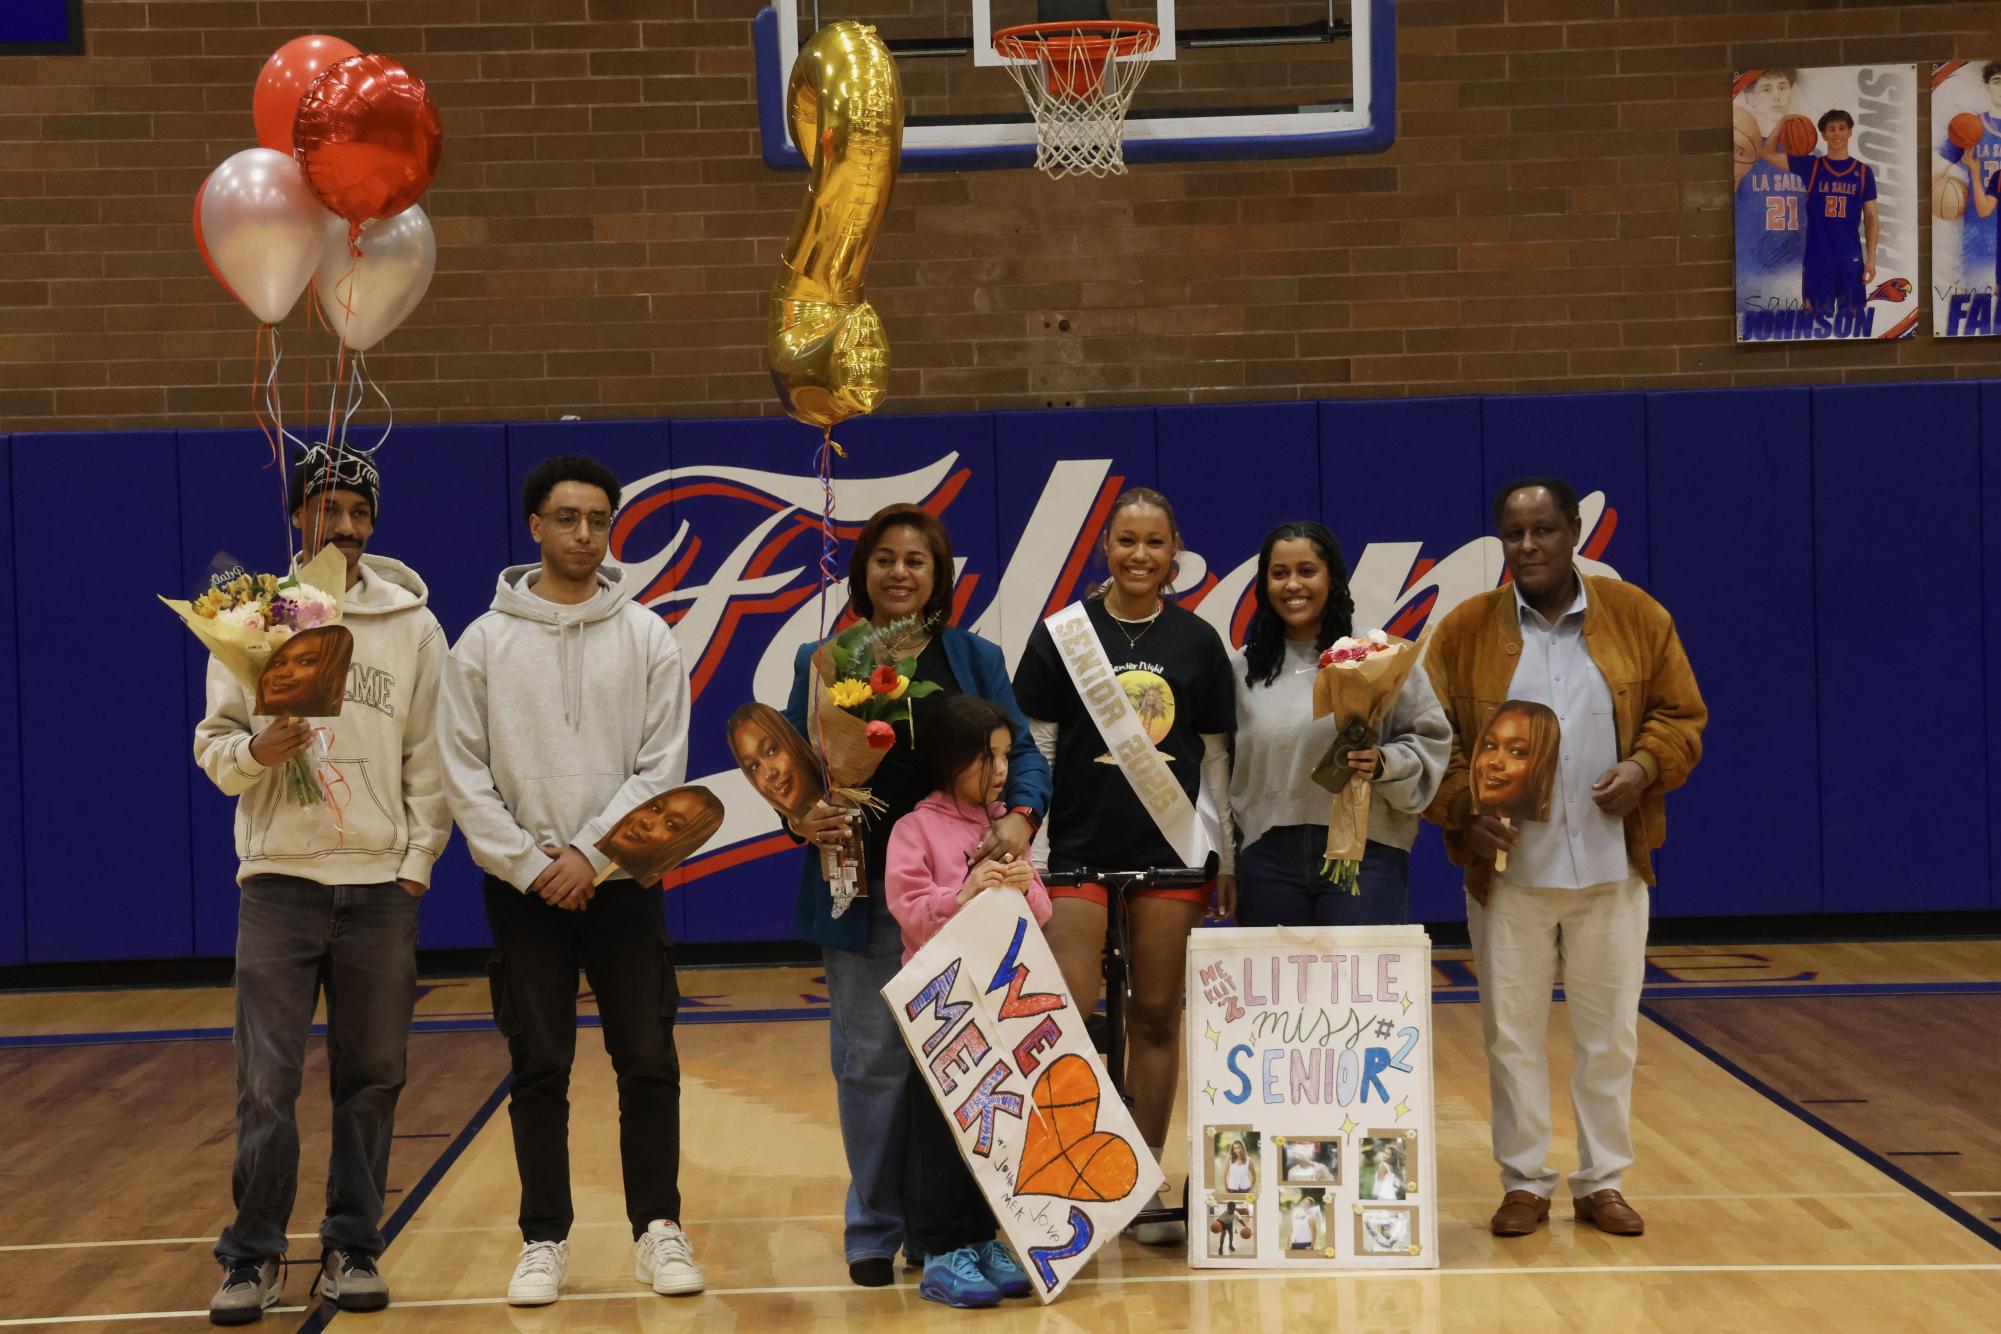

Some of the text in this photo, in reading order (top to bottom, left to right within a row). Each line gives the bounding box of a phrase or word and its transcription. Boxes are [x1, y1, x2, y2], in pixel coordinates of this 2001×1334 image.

[1752, 174, 1770, 192] LA
[1765, 196, 1798, 231] 21
[1825, 195, 1847, 218] 21
[1742, 307, 1876, 341] JOHNSON
[1055, 617, 1127, 729] SENIOR
[1113, 662, 1138, 672] enior
[985, 916, 1067, 1079] WE
[1243, 954, 1401, 1006] LITTLE
[1223, 1044, 1391, 1108] SENIOR
[905, 957, 1095, 1294] MEK 2
